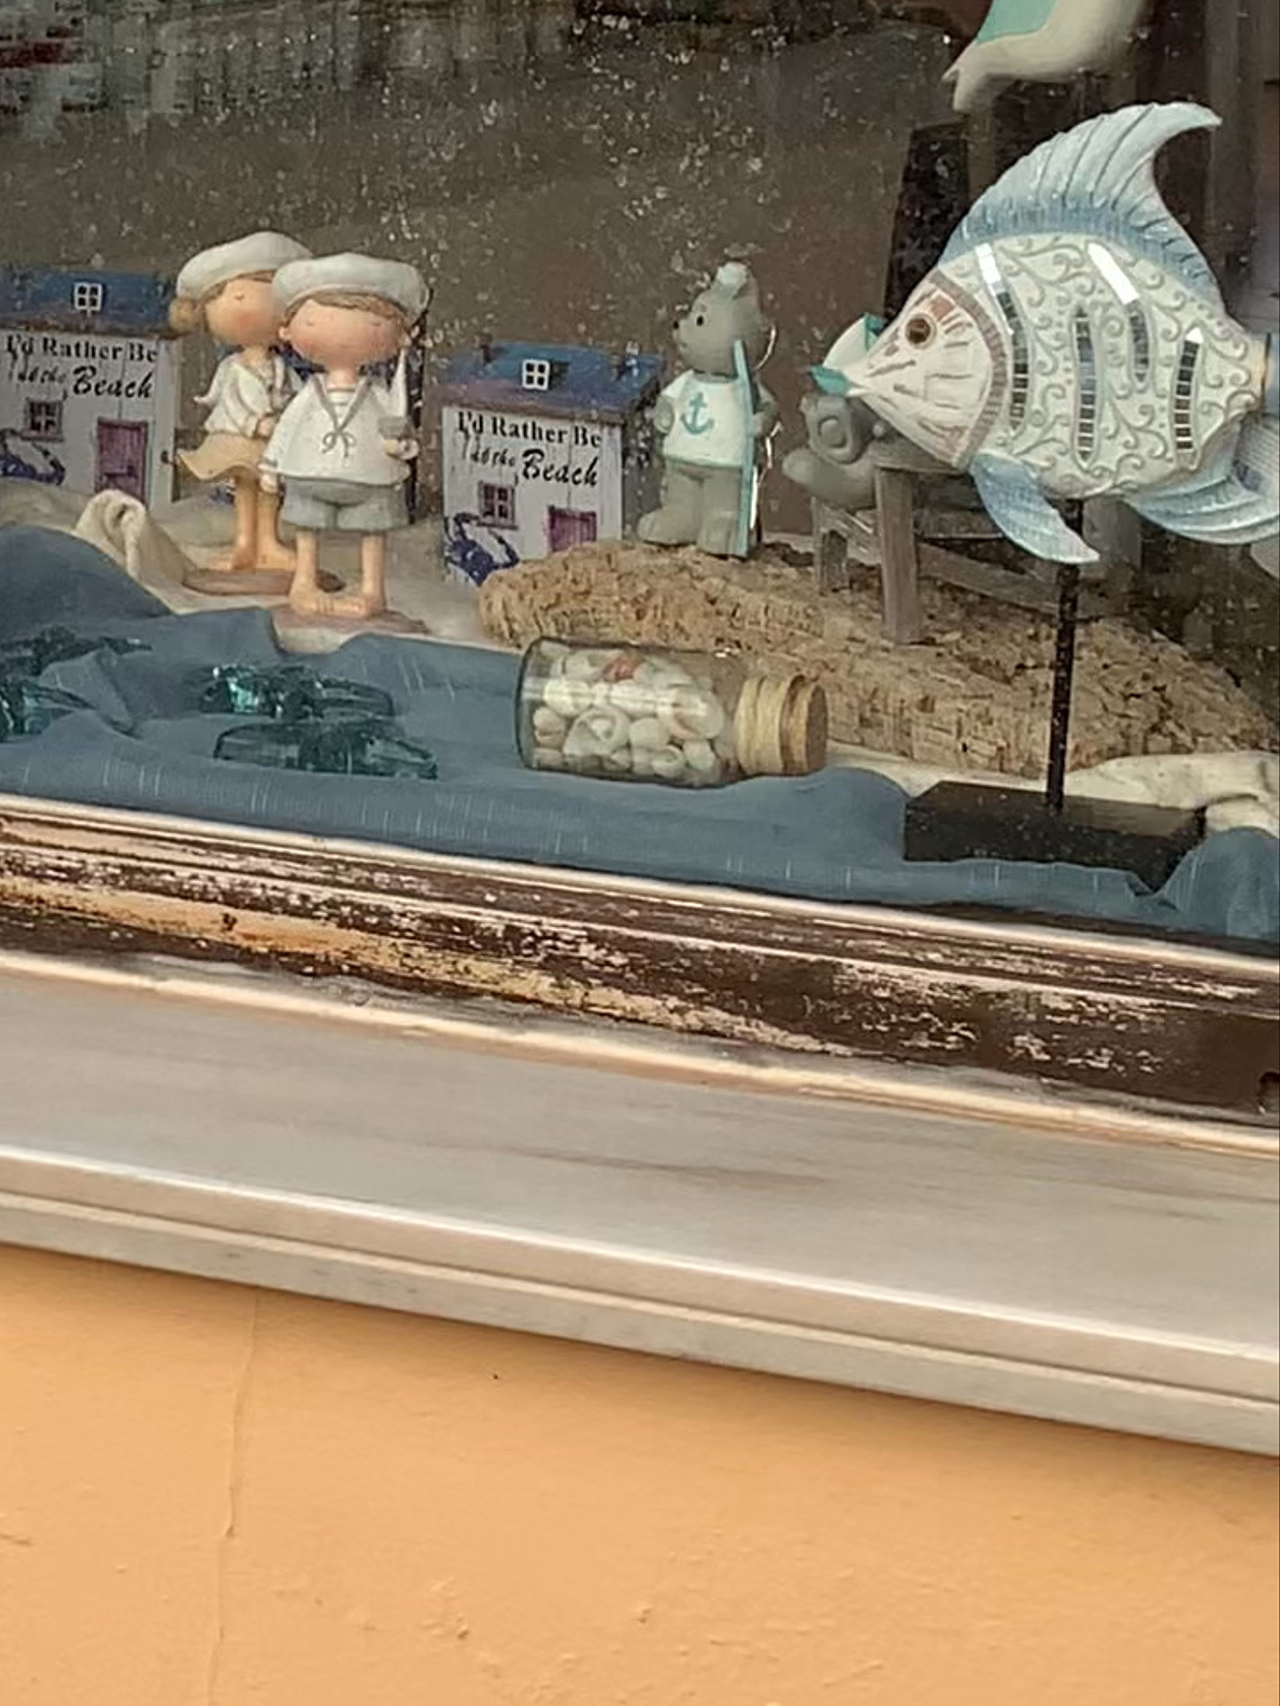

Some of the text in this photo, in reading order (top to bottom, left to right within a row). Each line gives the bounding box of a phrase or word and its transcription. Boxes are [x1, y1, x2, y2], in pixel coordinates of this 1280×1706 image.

[42, 337, 123, 360] Rather
[129, 342, 158, 363] Be
[72, 364, 154, 398] Beach
[492, 416, 568, 444] Rather
[574, 425, 602, 448] Be
[522, 448, 599, 487] Beach
